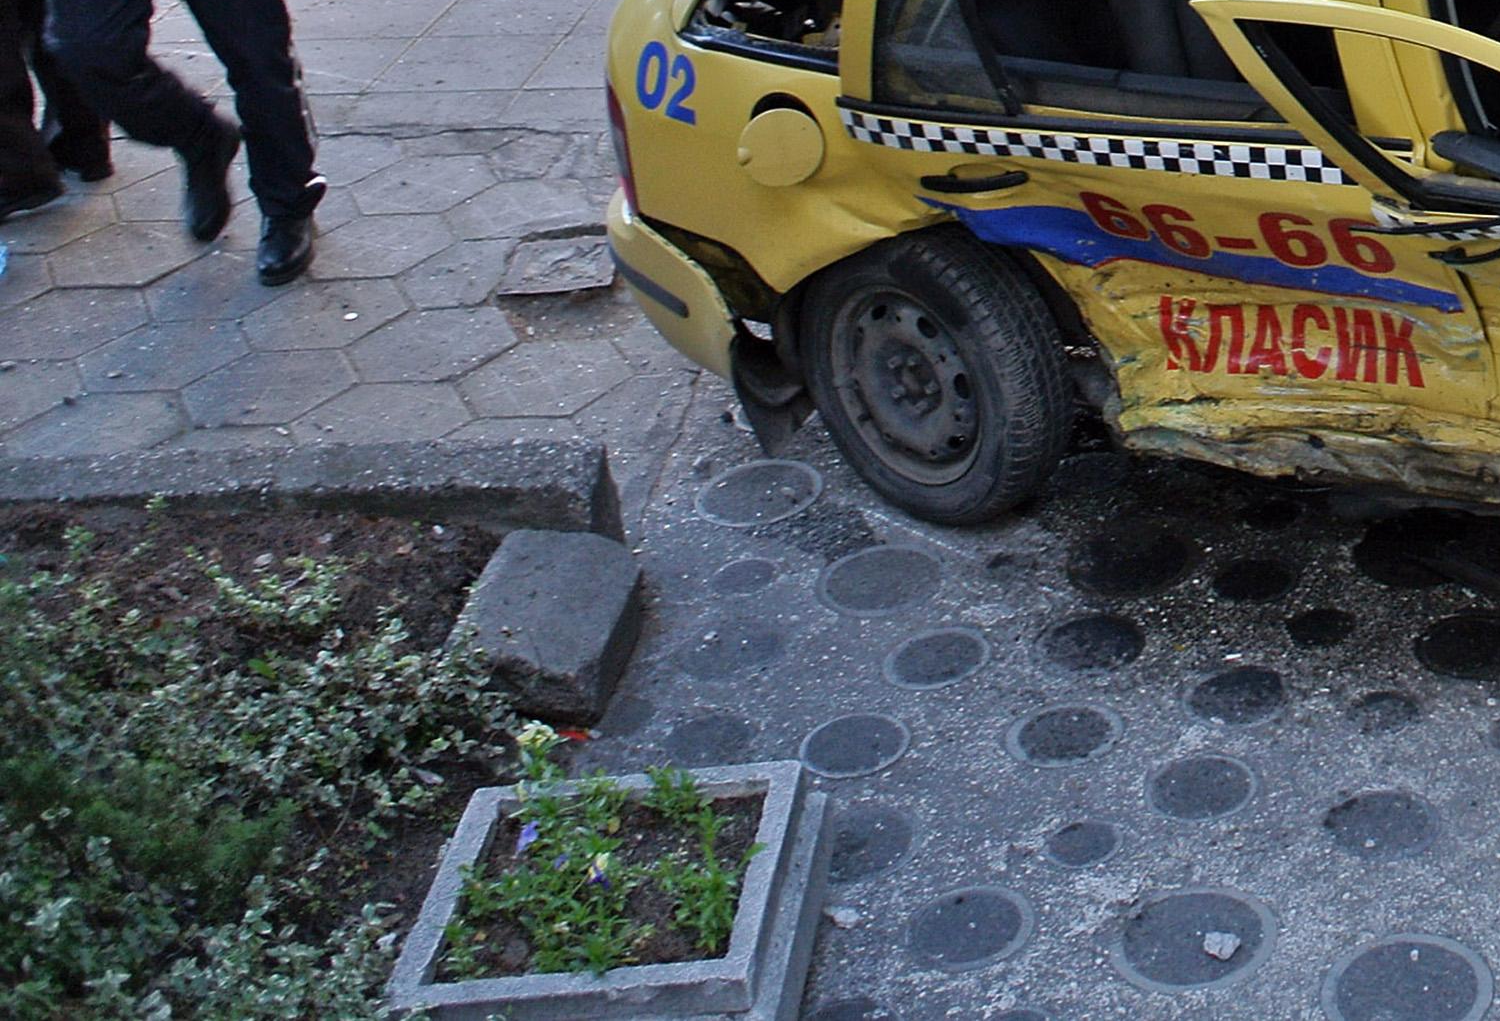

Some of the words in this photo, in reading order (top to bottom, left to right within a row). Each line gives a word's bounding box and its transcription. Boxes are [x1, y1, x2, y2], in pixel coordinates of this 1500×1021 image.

[636, 41, 696, 126] 02
[1079, 191, 1395, 273] 66-66
[1159, 294, 1425, 388] КЛАСИК
